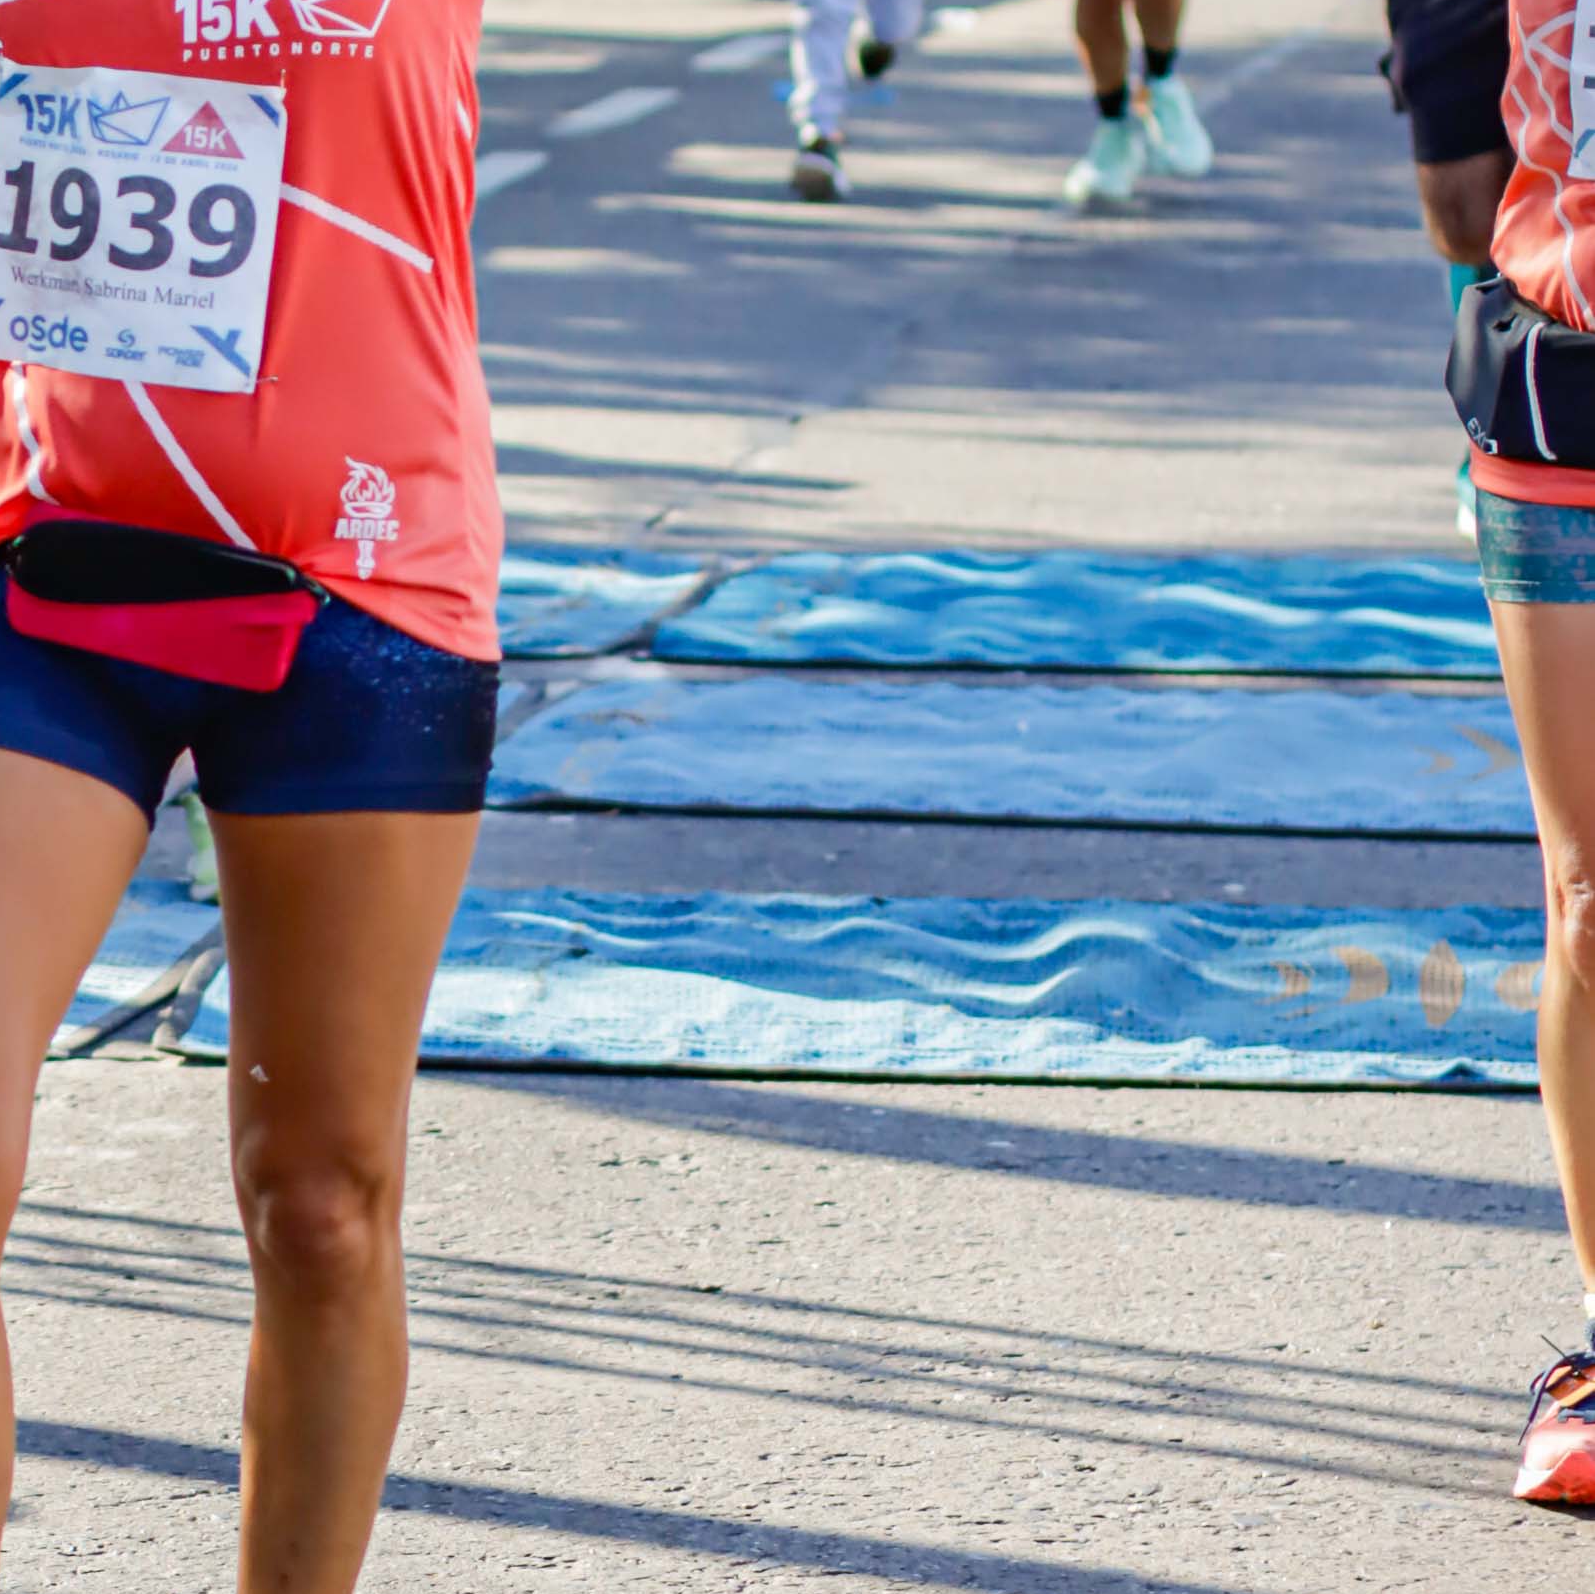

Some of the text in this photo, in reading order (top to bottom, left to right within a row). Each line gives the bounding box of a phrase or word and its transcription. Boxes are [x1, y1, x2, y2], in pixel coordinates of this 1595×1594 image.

[182, 41, 375, 62] PUERTO NORTE
[16, 93, 80, 139] 15K
[183, 124, 227, 151] 15K
[83, 276, 147, 303] Sabrina
[155, 286, 215, 309] Mariel
[333, 517, 400, 542] ARDEC
